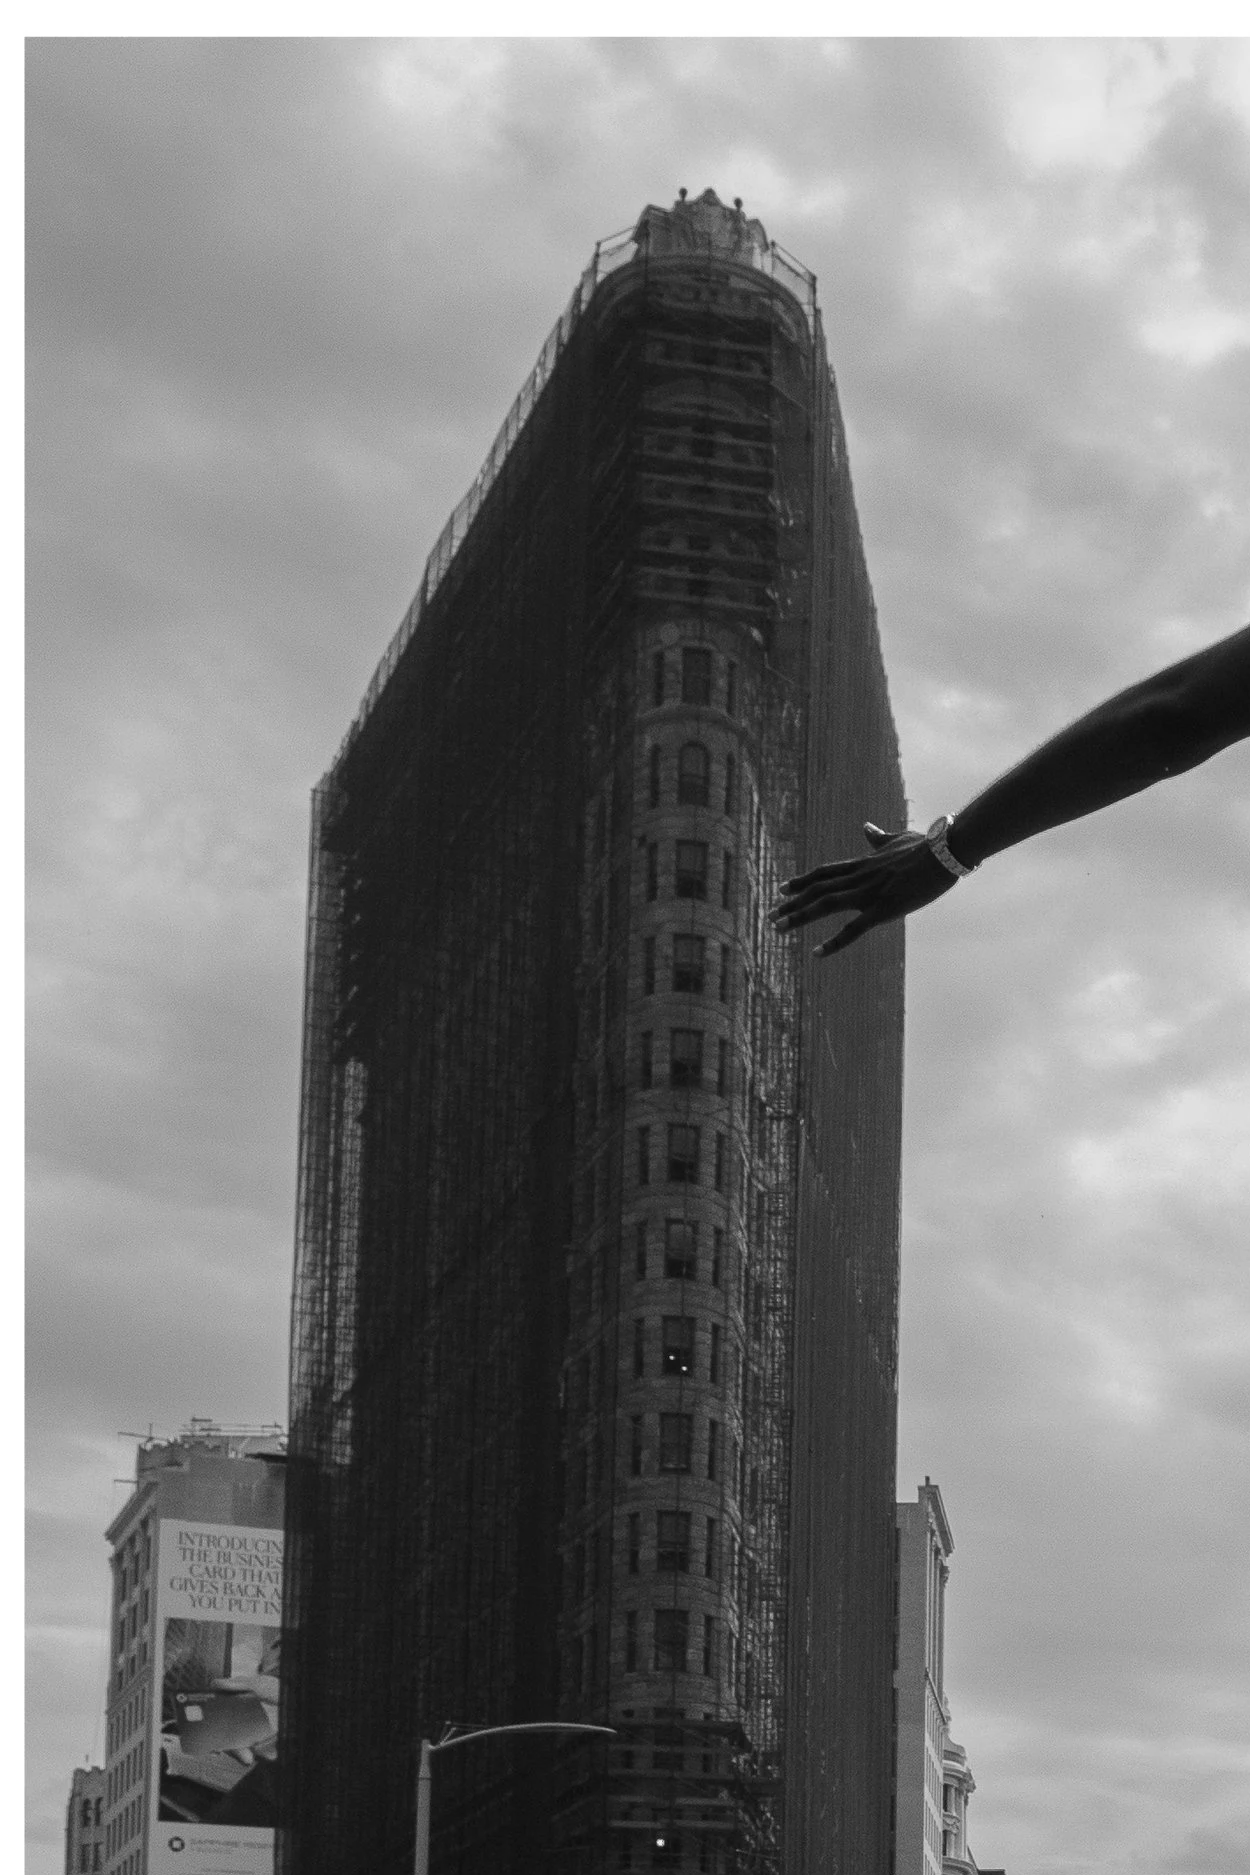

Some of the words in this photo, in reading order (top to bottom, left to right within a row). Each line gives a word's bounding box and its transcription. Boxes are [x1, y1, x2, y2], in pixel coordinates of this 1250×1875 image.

[178, 1530, 283, 1554] INTRODUCIN
[179, 1547, 212, 1562] THE
[217, 1550, 283, 1569] BUSINES
[190, 1563, 236, 1580] CARD
[241, 1567, 282, 1585] THAT
[169, 1576, 219, 1594] GIVES
[222, 1581, 266, 1598] BACK
[189, 1593, 224, 1610] YOU
[228, 1598, 258, 1613] PUT
